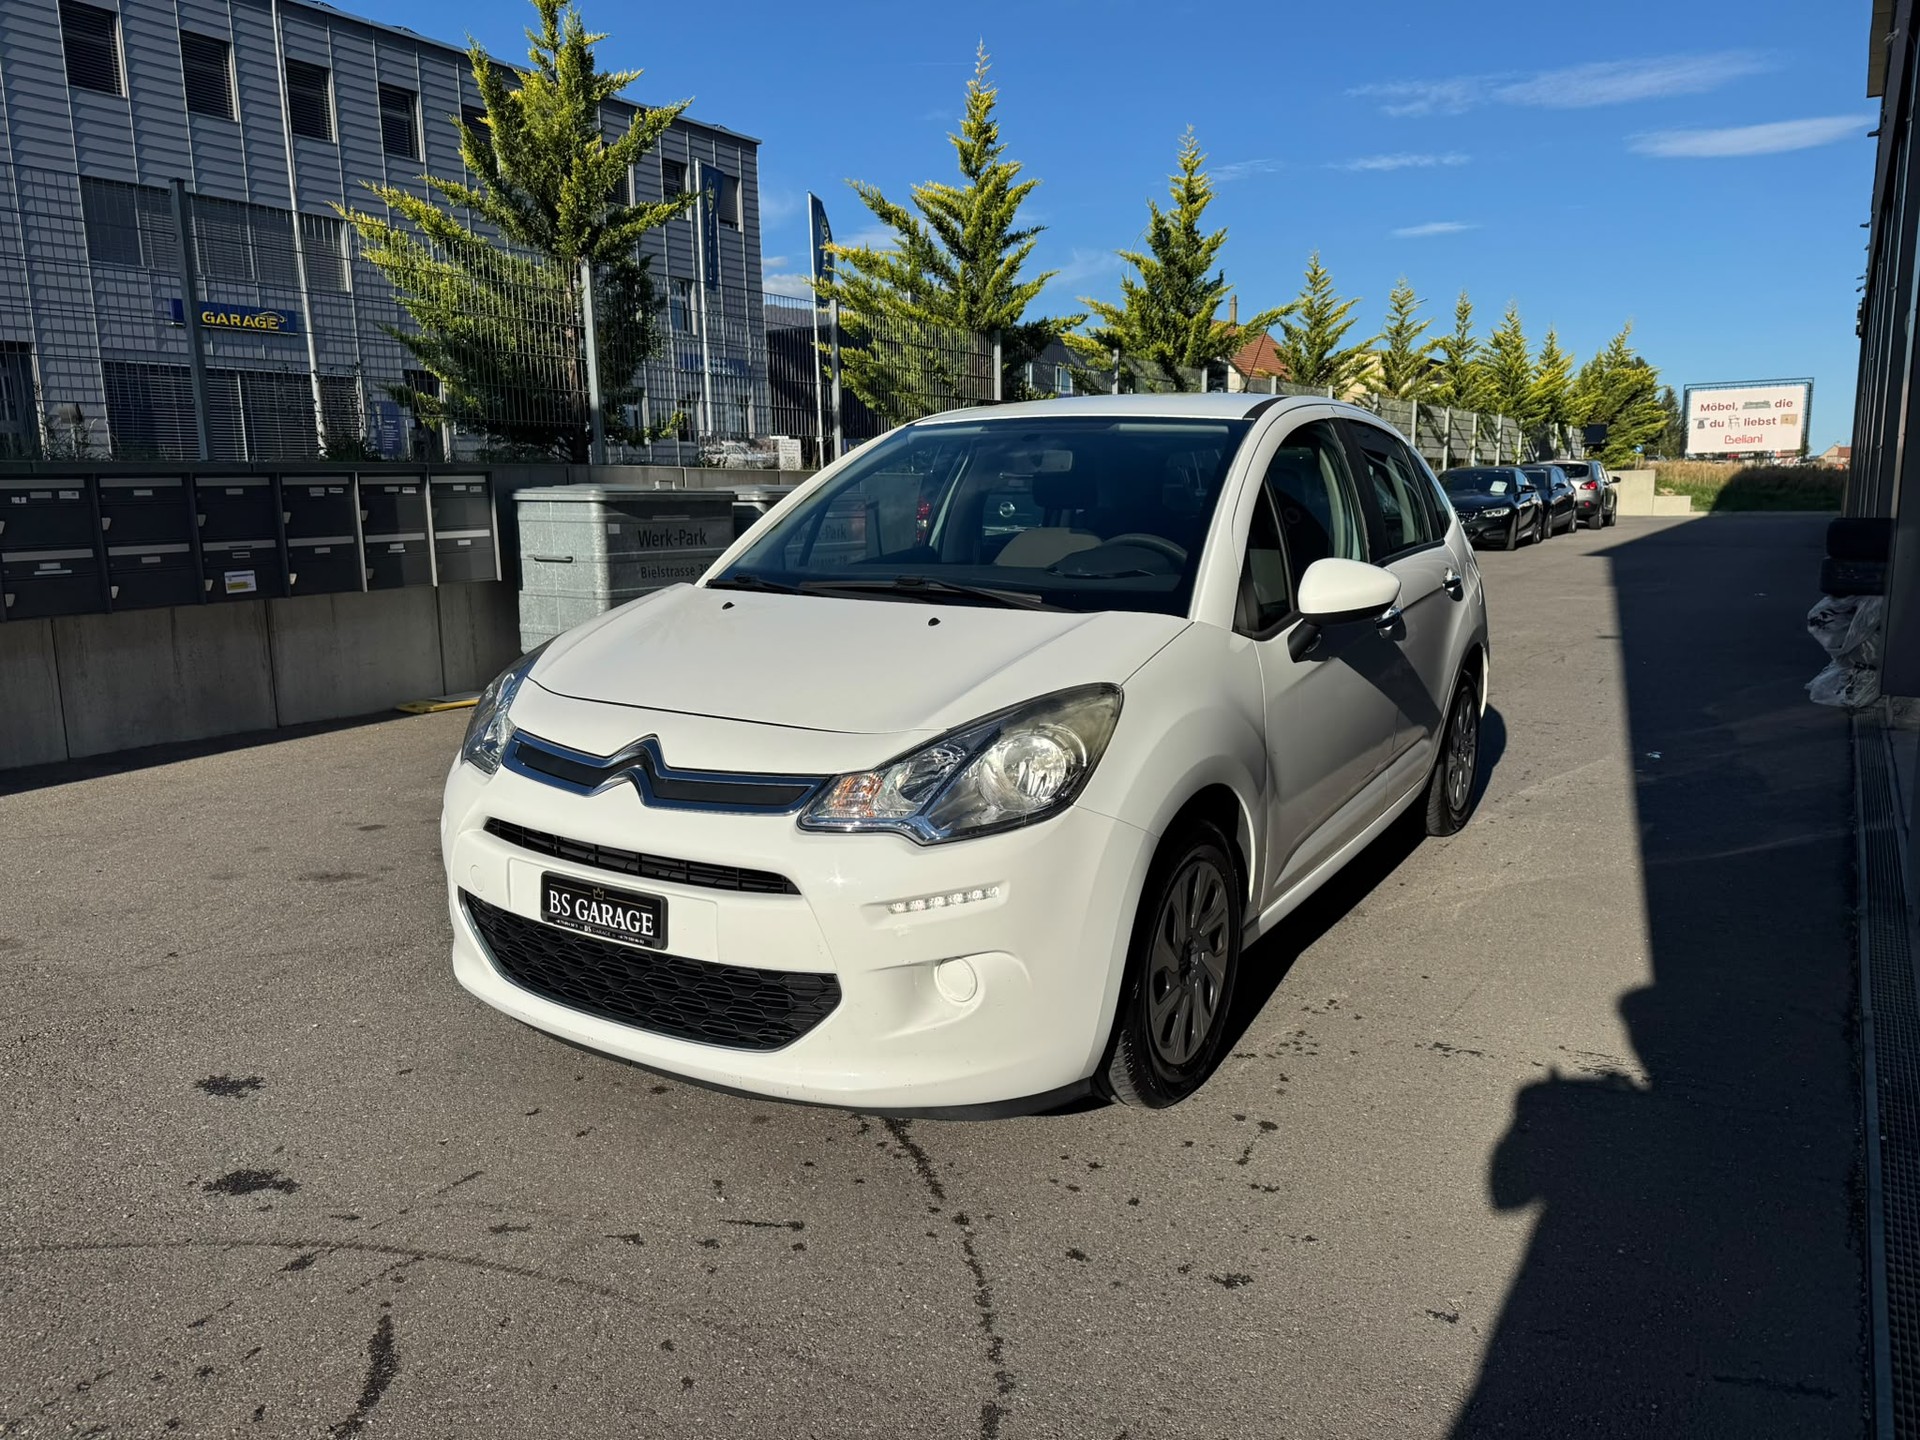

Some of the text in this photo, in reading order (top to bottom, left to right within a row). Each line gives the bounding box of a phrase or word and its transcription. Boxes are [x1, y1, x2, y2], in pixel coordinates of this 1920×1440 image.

[201, 311, 280, 330] GARAGE
[1700, 398, 1793, 412] Möbel, die
[1710, 417, 1776, 428] du liebst
[1724, 434, 1762, 444] Beliani
[637, 527, 708, 548] Werk-Park
[640, 565, 696, 579] Bielstrasse
[548, 889, 654, 936] BS GARAGE
